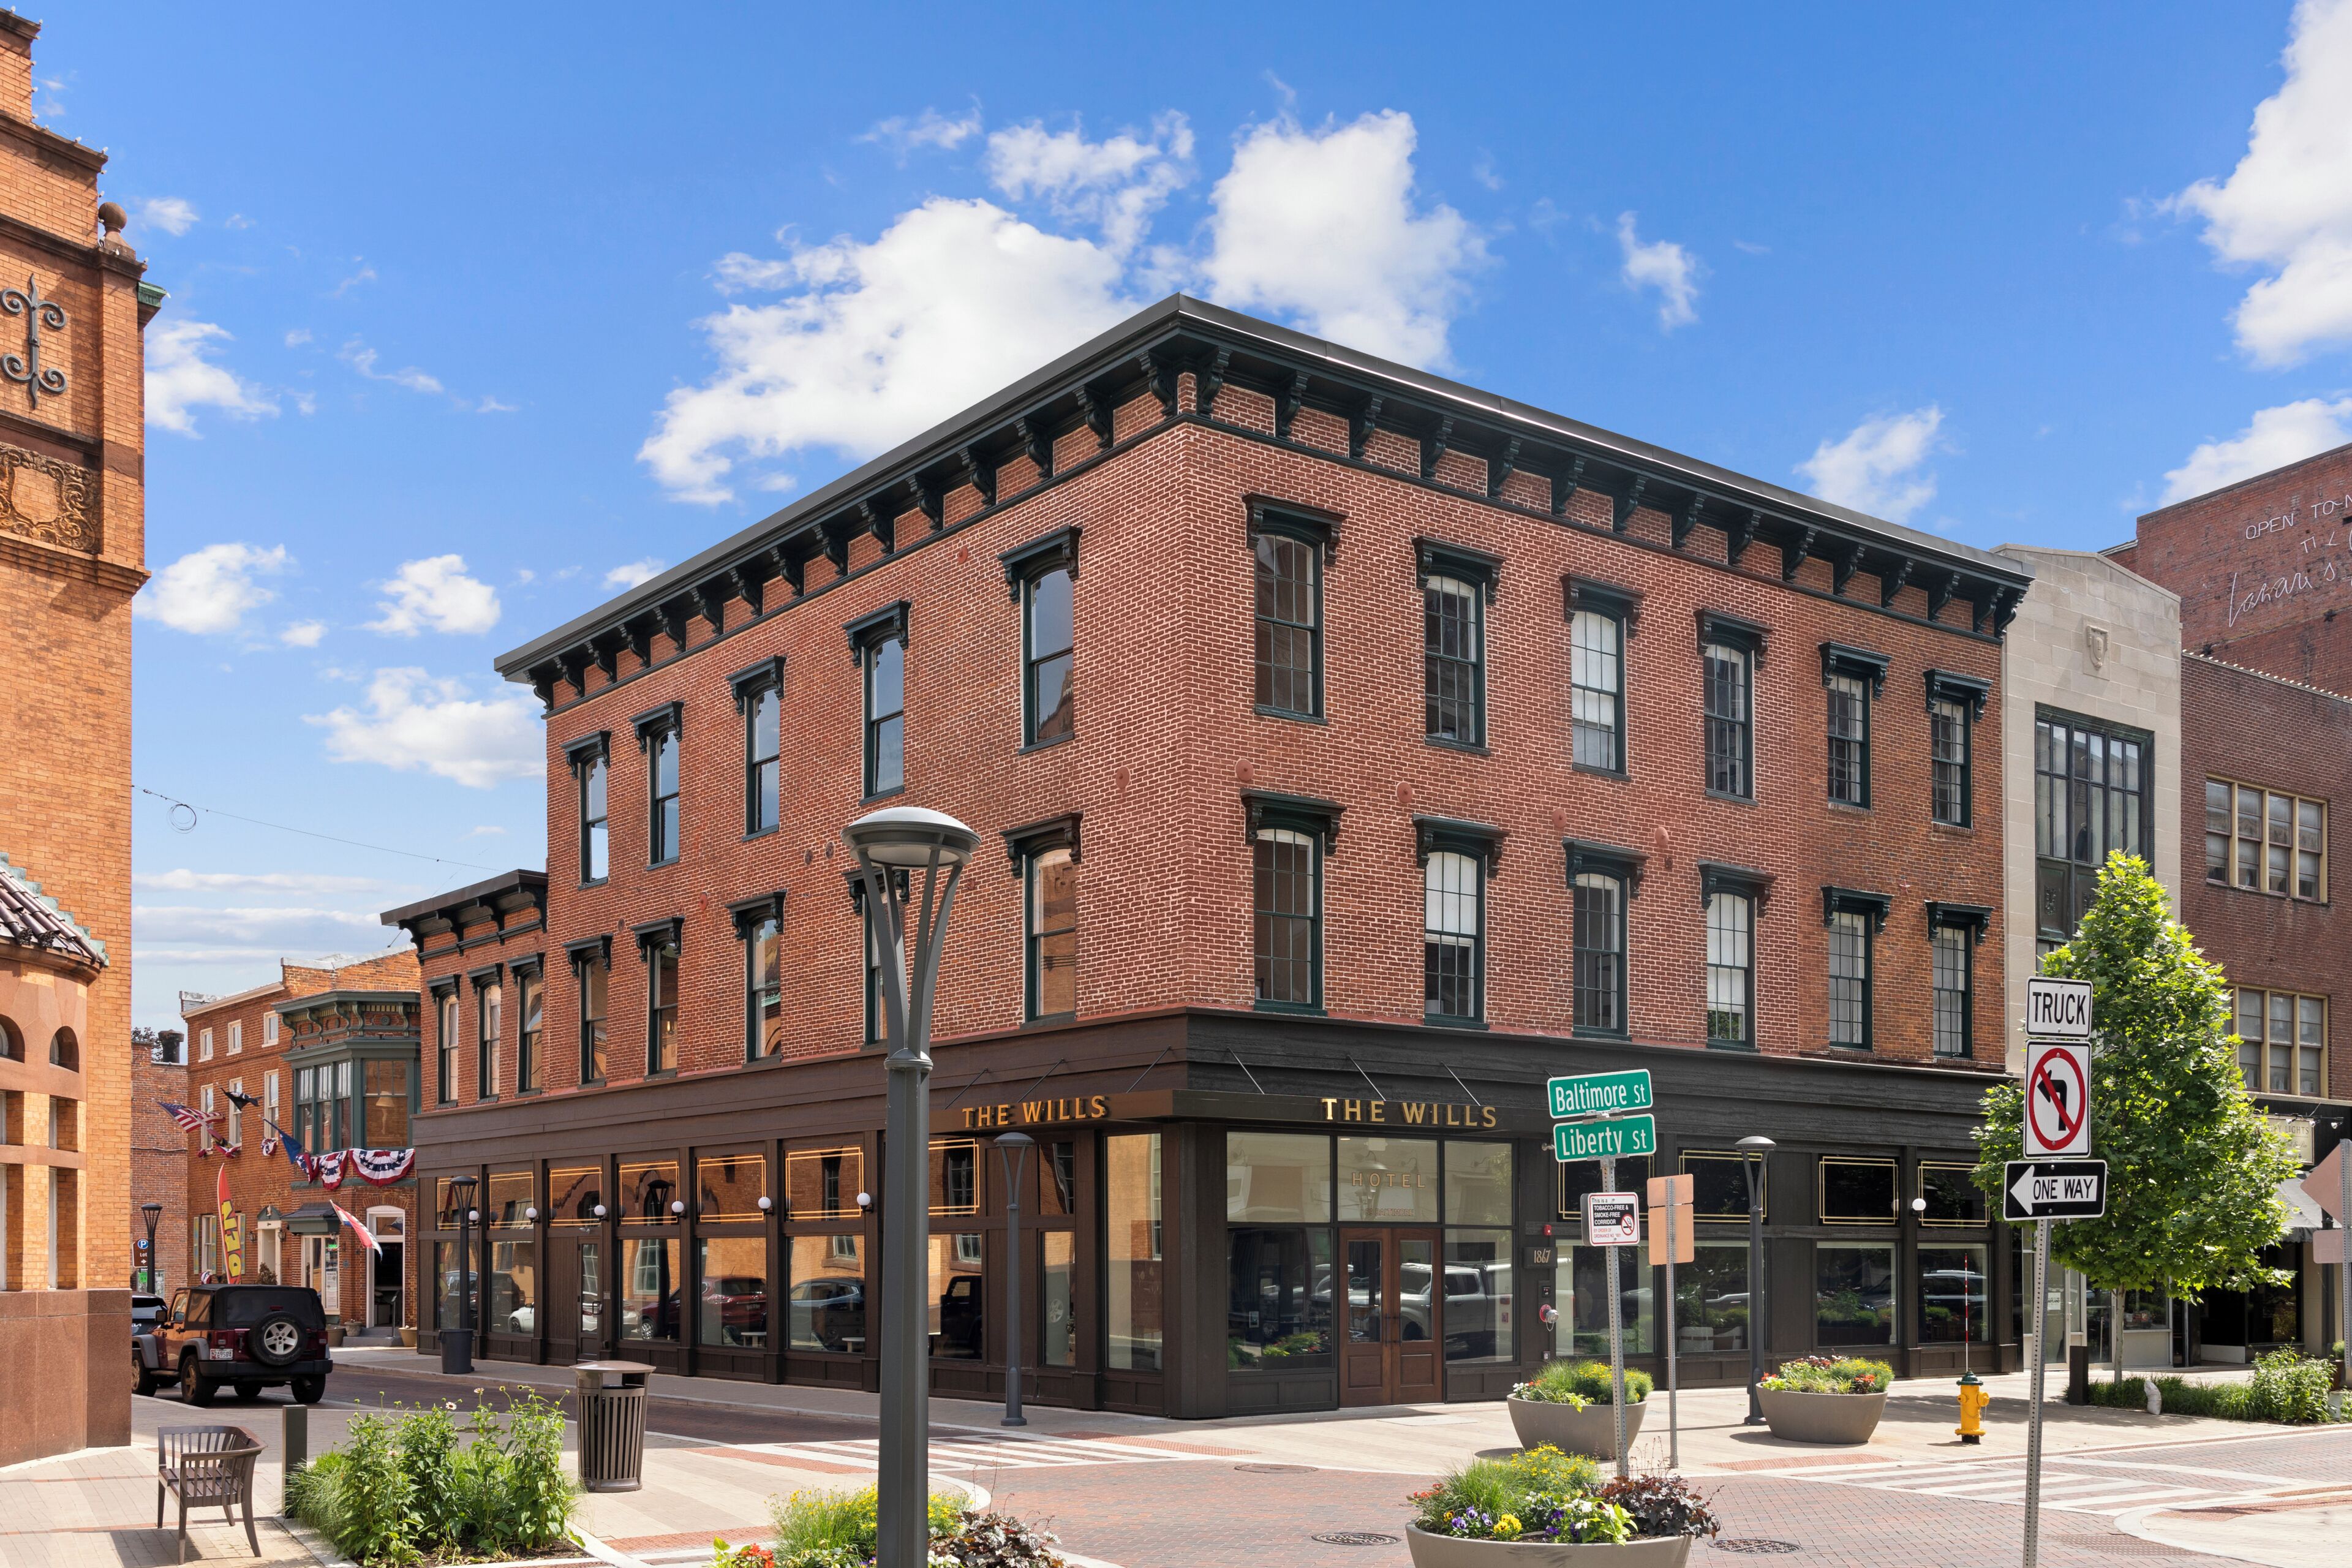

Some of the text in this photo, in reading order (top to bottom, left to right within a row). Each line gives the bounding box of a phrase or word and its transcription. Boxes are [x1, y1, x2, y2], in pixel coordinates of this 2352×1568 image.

[2246, 513, 2294, 540] OPEN
[2032, 991, 2087, 1025] TRUCK
[962, 1095, 1106, 1128] THE WILLS
[1555, 1082, 1646, 1112] Baltimore St
[1321, 1098, 1497, 1128] THE WILLS
[1561, 1127, 1647, 1156] Liberty St
[1352, 1172, 1426, 1188] HOTEL
[2033, 1178, 2094, 1200] ONE WAY
[1534, 1248, 1551, 1264] 1867
